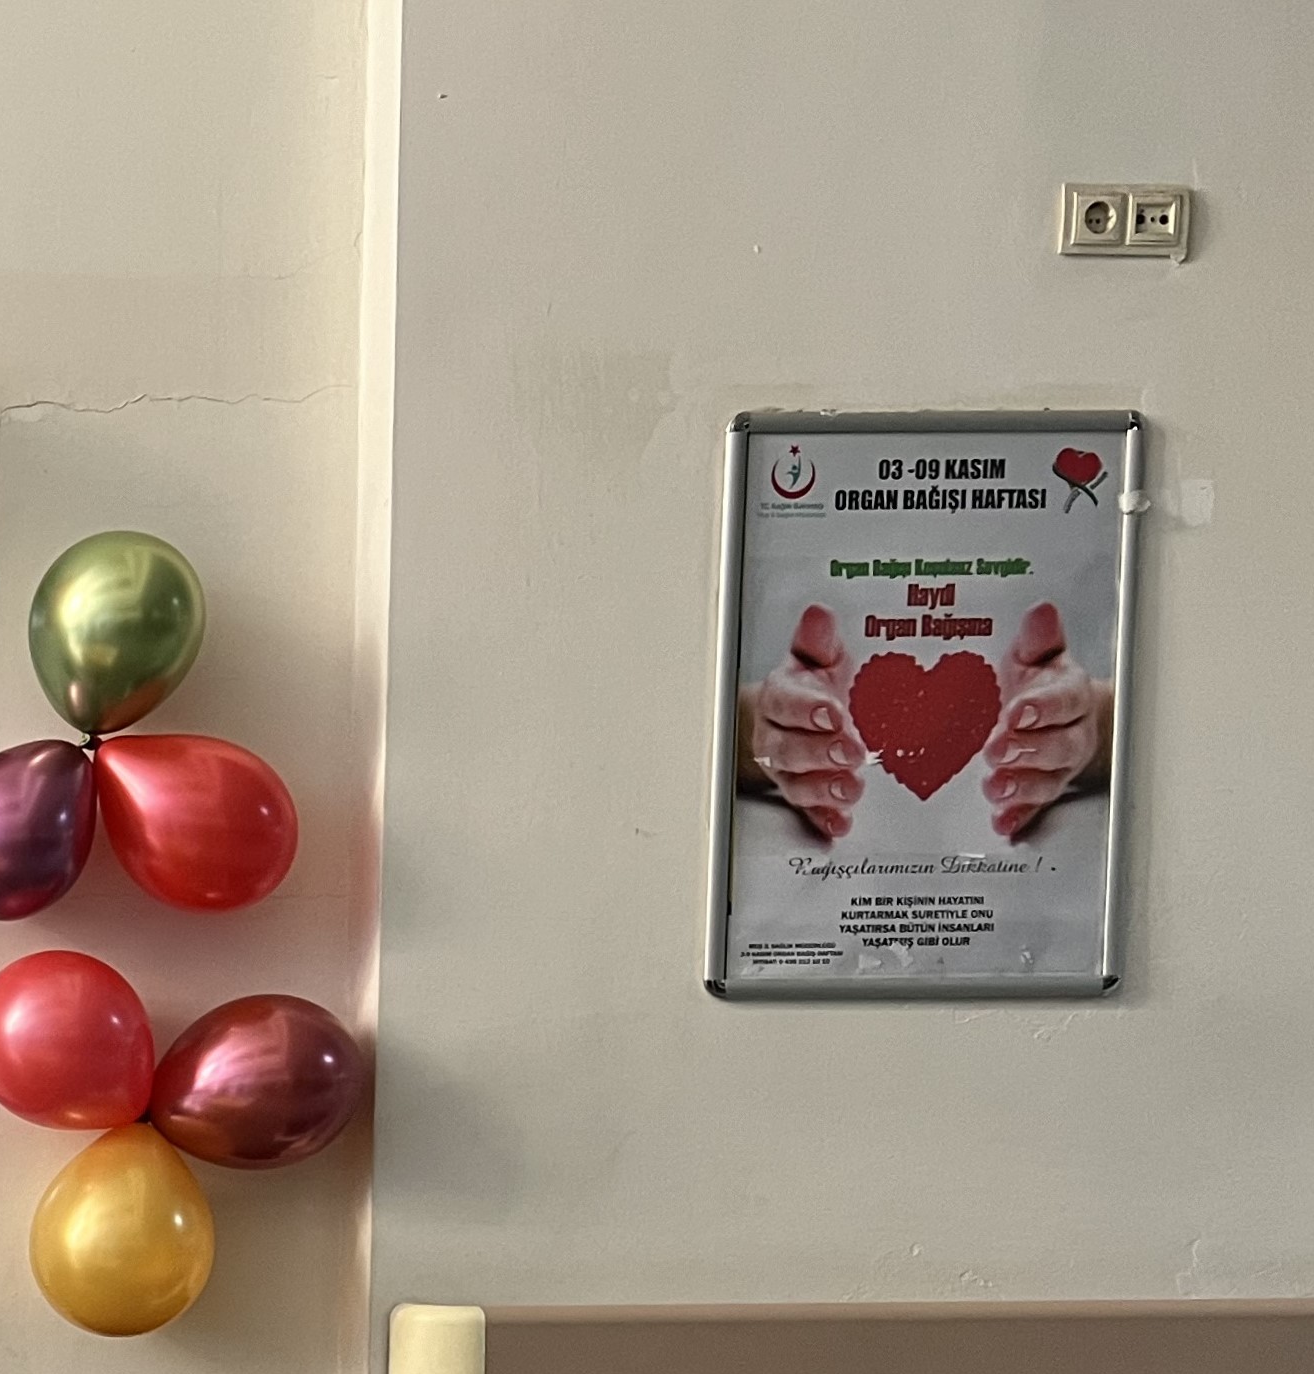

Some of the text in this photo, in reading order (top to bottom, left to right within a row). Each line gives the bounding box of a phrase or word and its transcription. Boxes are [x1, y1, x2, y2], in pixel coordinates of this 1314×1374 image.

[878, 458, 1006, 480] 03 -09 KASIM
[835, 489, 898, 511] ORGAN
[903, 485, 967, 514] BAĞIŞI
[971, 488, 1047, 509] HAFTASI
[907, 583, 956, 610] Haydi
[865, 614, 917, 641] Organ
[851, 895, 872, 906] KİM
[875, 896, 893, 906] BİR
[938, 896, 984, 906] HAYATINI
[841, 909, 994, 920] KURTARMAK SURETİYLE ONU
[839, 922, 995, 935] YAŞATIRSA BÜTÜN İNSANLARI
[916, 936, 970, 947] GİBİ OLUR
